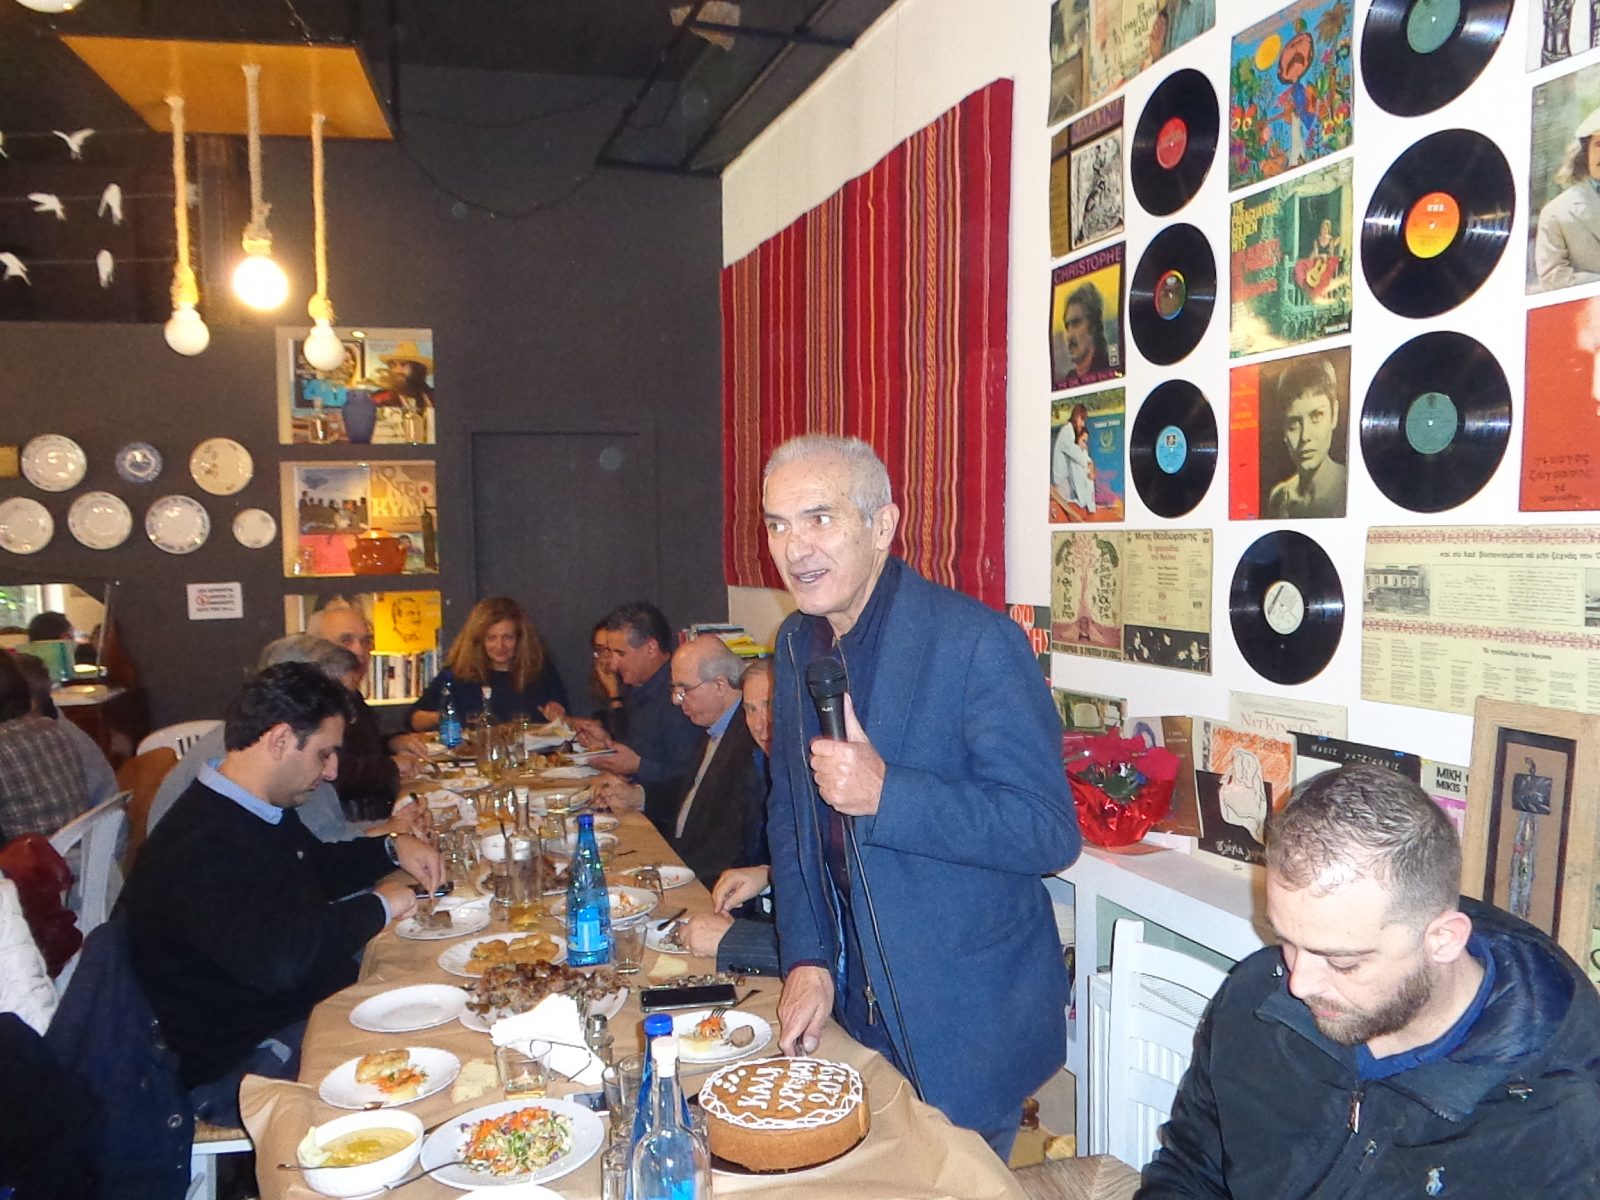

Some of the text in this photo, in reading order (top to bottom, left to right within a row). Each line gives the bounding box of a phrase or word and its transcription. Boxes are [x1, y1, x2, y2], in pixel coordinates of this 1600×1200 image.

[1054, 247, 1122, 284] CHRISTOPHE
[1436, 779, 1461, 793] MIKIS
[808, 1066, 847, 1106] 2019
